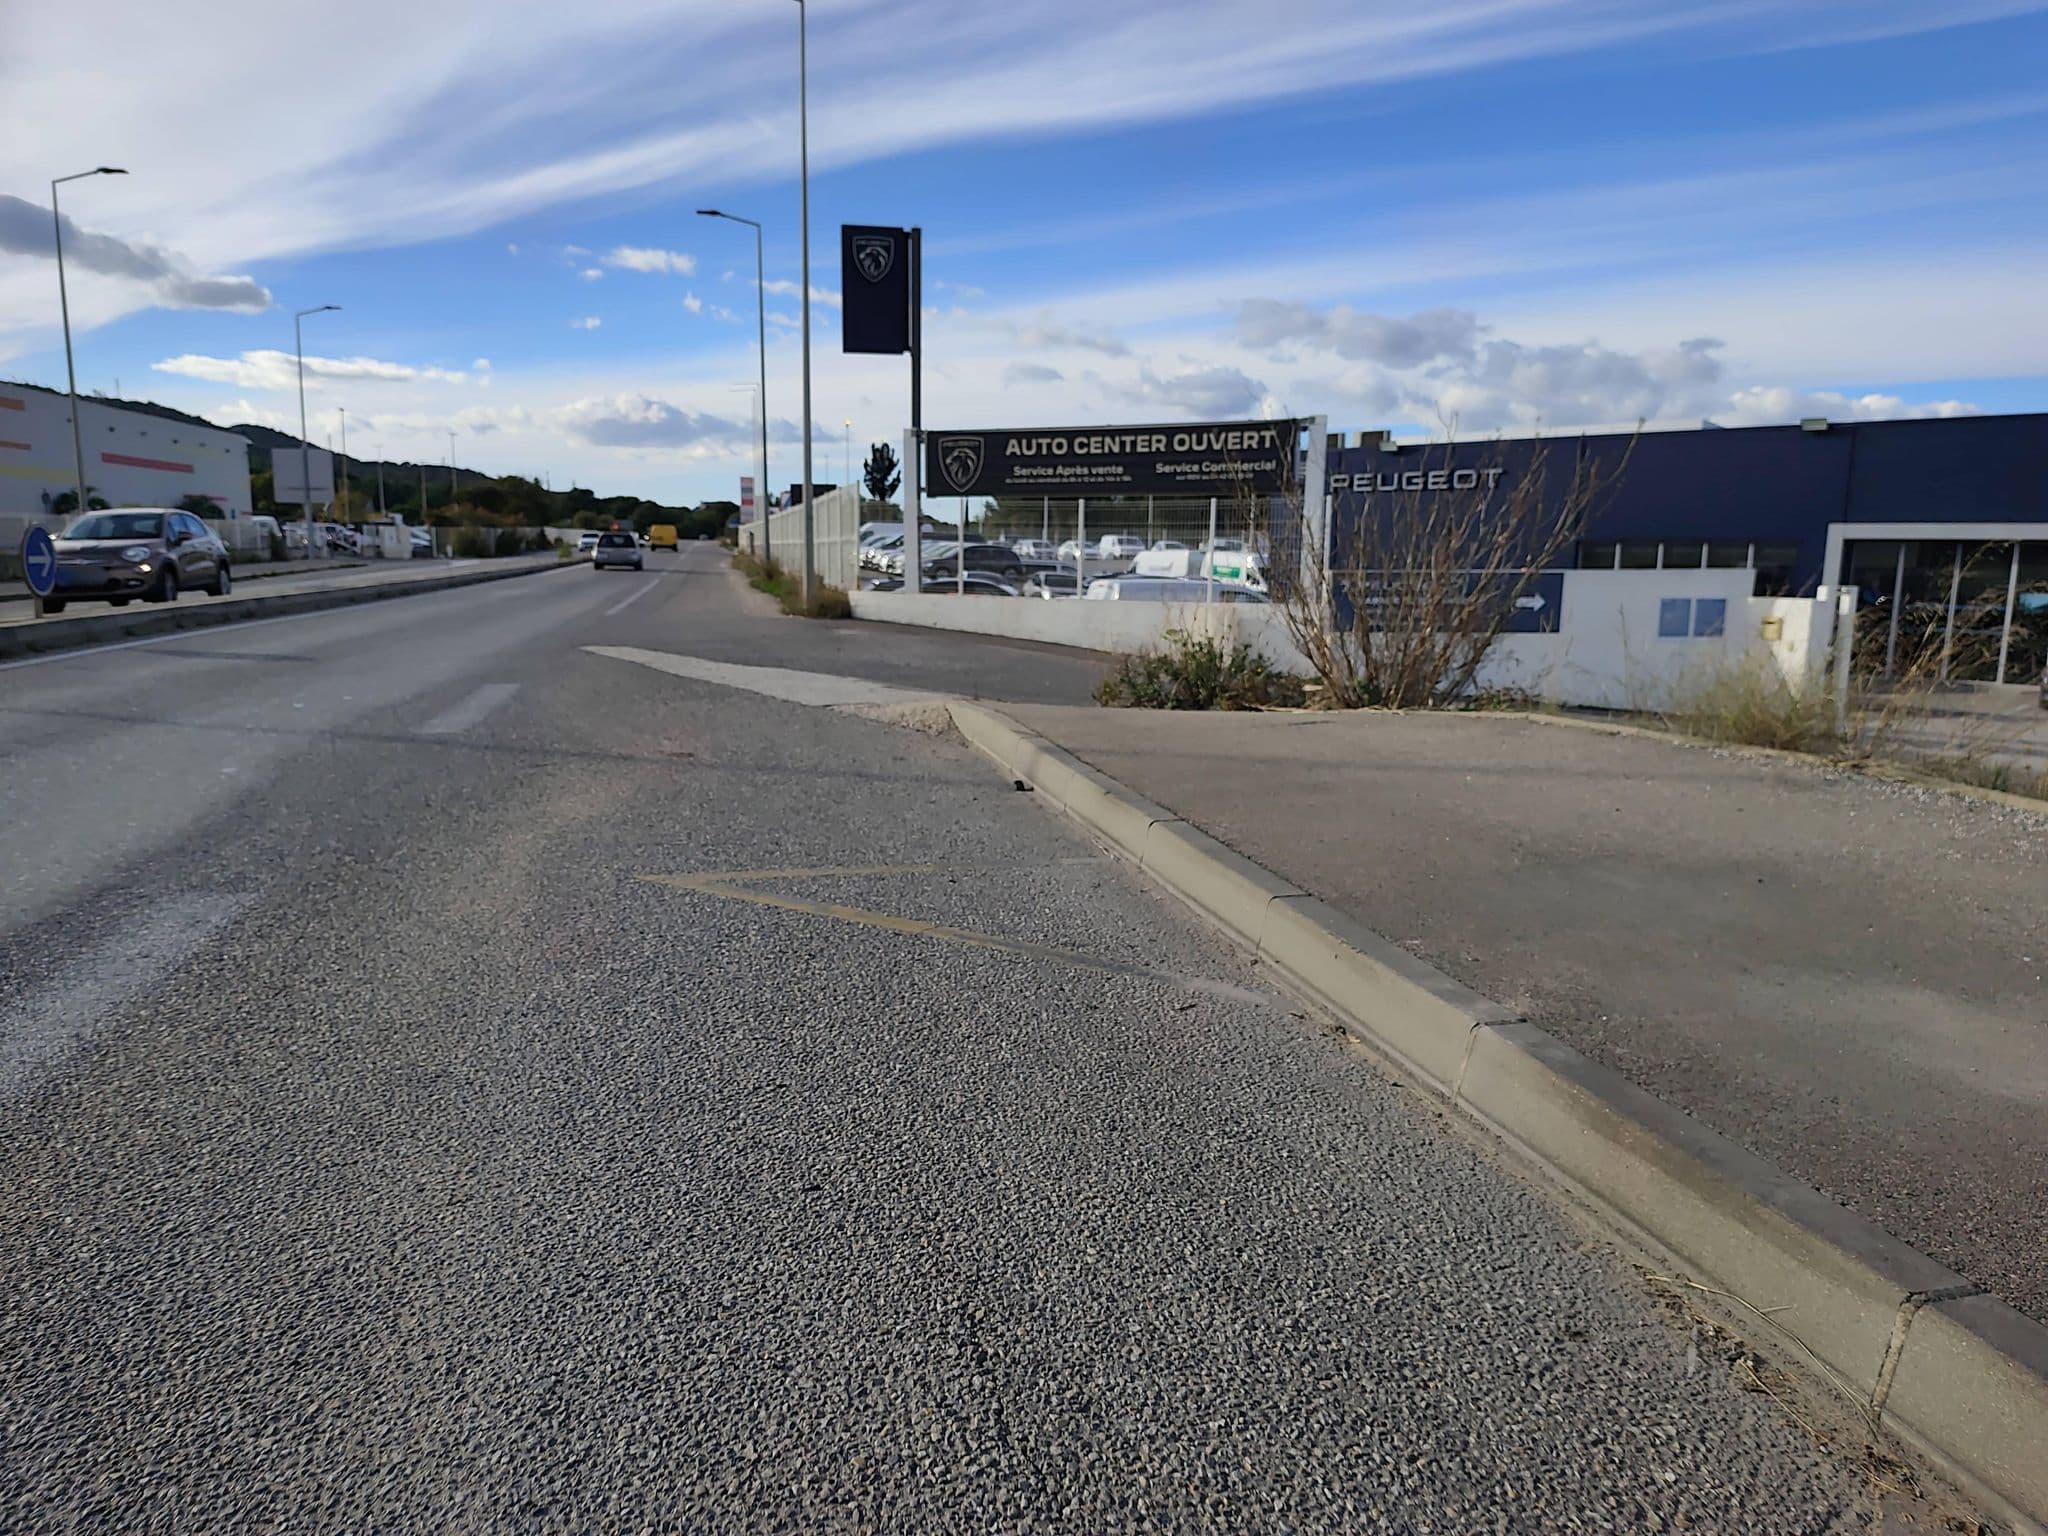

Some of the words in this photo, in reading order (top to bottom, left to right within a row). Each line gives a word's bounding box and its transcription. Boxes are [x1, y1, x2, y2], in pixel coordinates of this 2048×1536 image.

[1005, 438, 1068, 456] AUTO
[1073, 434, 1167, 454] CENTER
[1173, 430, 1274, 452] OUVERT
[1013, 466, 1054, 476] Service
[1091, 465, 1124, 475] vente
[1155, 462, 1200, 473] Service
[1330, 467, 1503, 492] PEUGEOT
